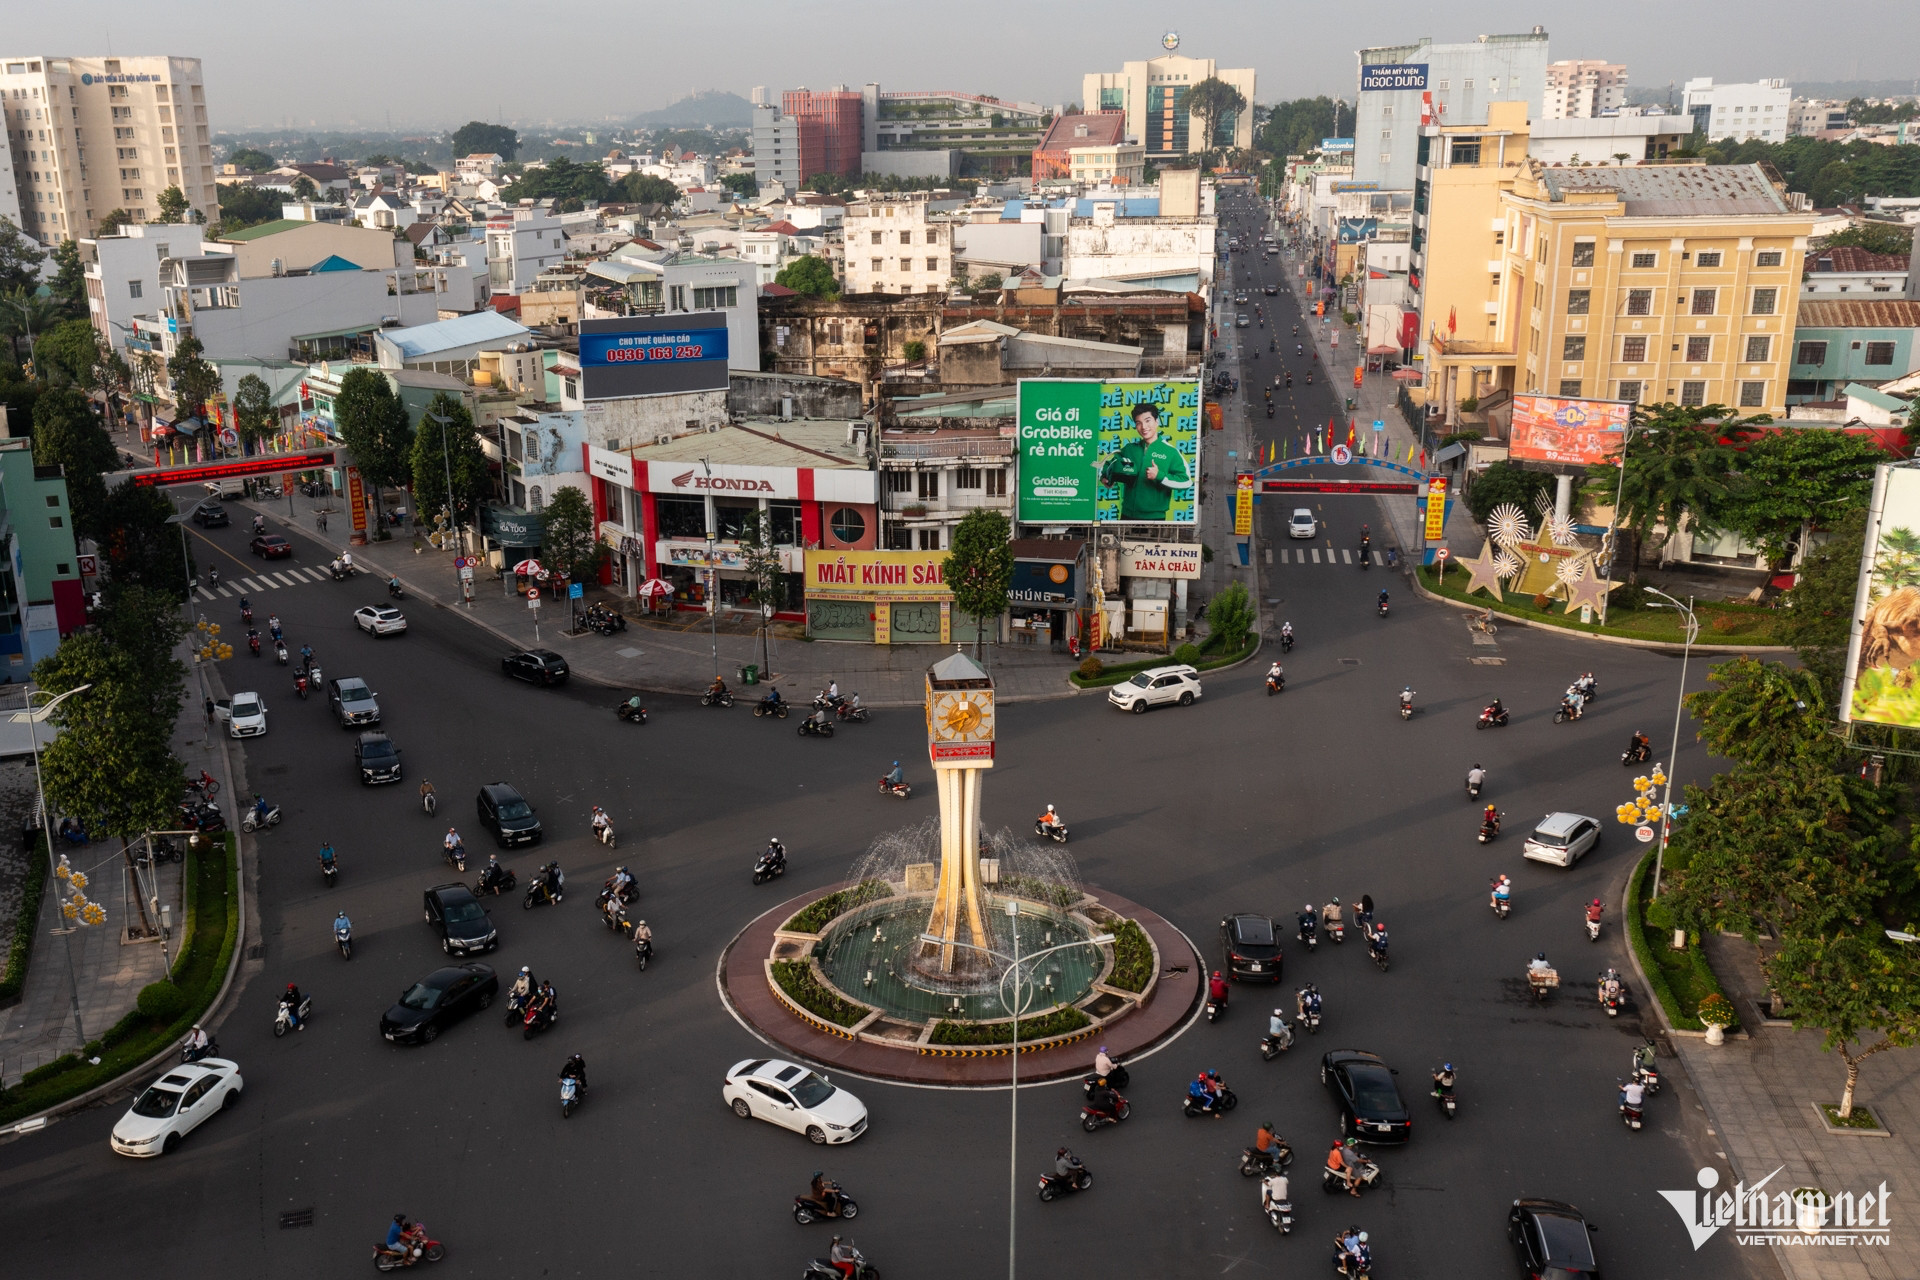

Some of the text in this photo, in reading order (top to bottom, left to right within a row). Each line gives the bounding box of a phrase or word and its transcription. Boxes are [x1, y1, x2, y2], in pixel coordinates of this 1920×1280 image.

[619, 334, 690, 346] CHO THUÊ QUẢNG CÁO
[606, 345, 702, 362] 0936 163 252
[1100, 386, 1123, 408] RẺ
[1125, 384, 1174, 406] NHẤT
[1035, 408, 1080, 421] Giá đi
[1100, 411, 1122, 432] RẺ
[1022, 425, 1092, 439] GrabBike
[1029, 441, 1084, 457] rẻ nhất
[1099, 434, 1121, 455] RẺ
[1152, 452, 1166, 460] Grab
[1545, 451, 1558, 460] 9.9
[694, 477, 775, 492] HONDA
[1032, 476, 1079, 486] GrabBike
[1145, 544, 1198, 558] MẮT KÍNH
[817, 555, 857, 584] MẮT
[862, 560, 907, 585] KÍNH
[1135, 559, 1196, 572] TÂN Á CHÂU
